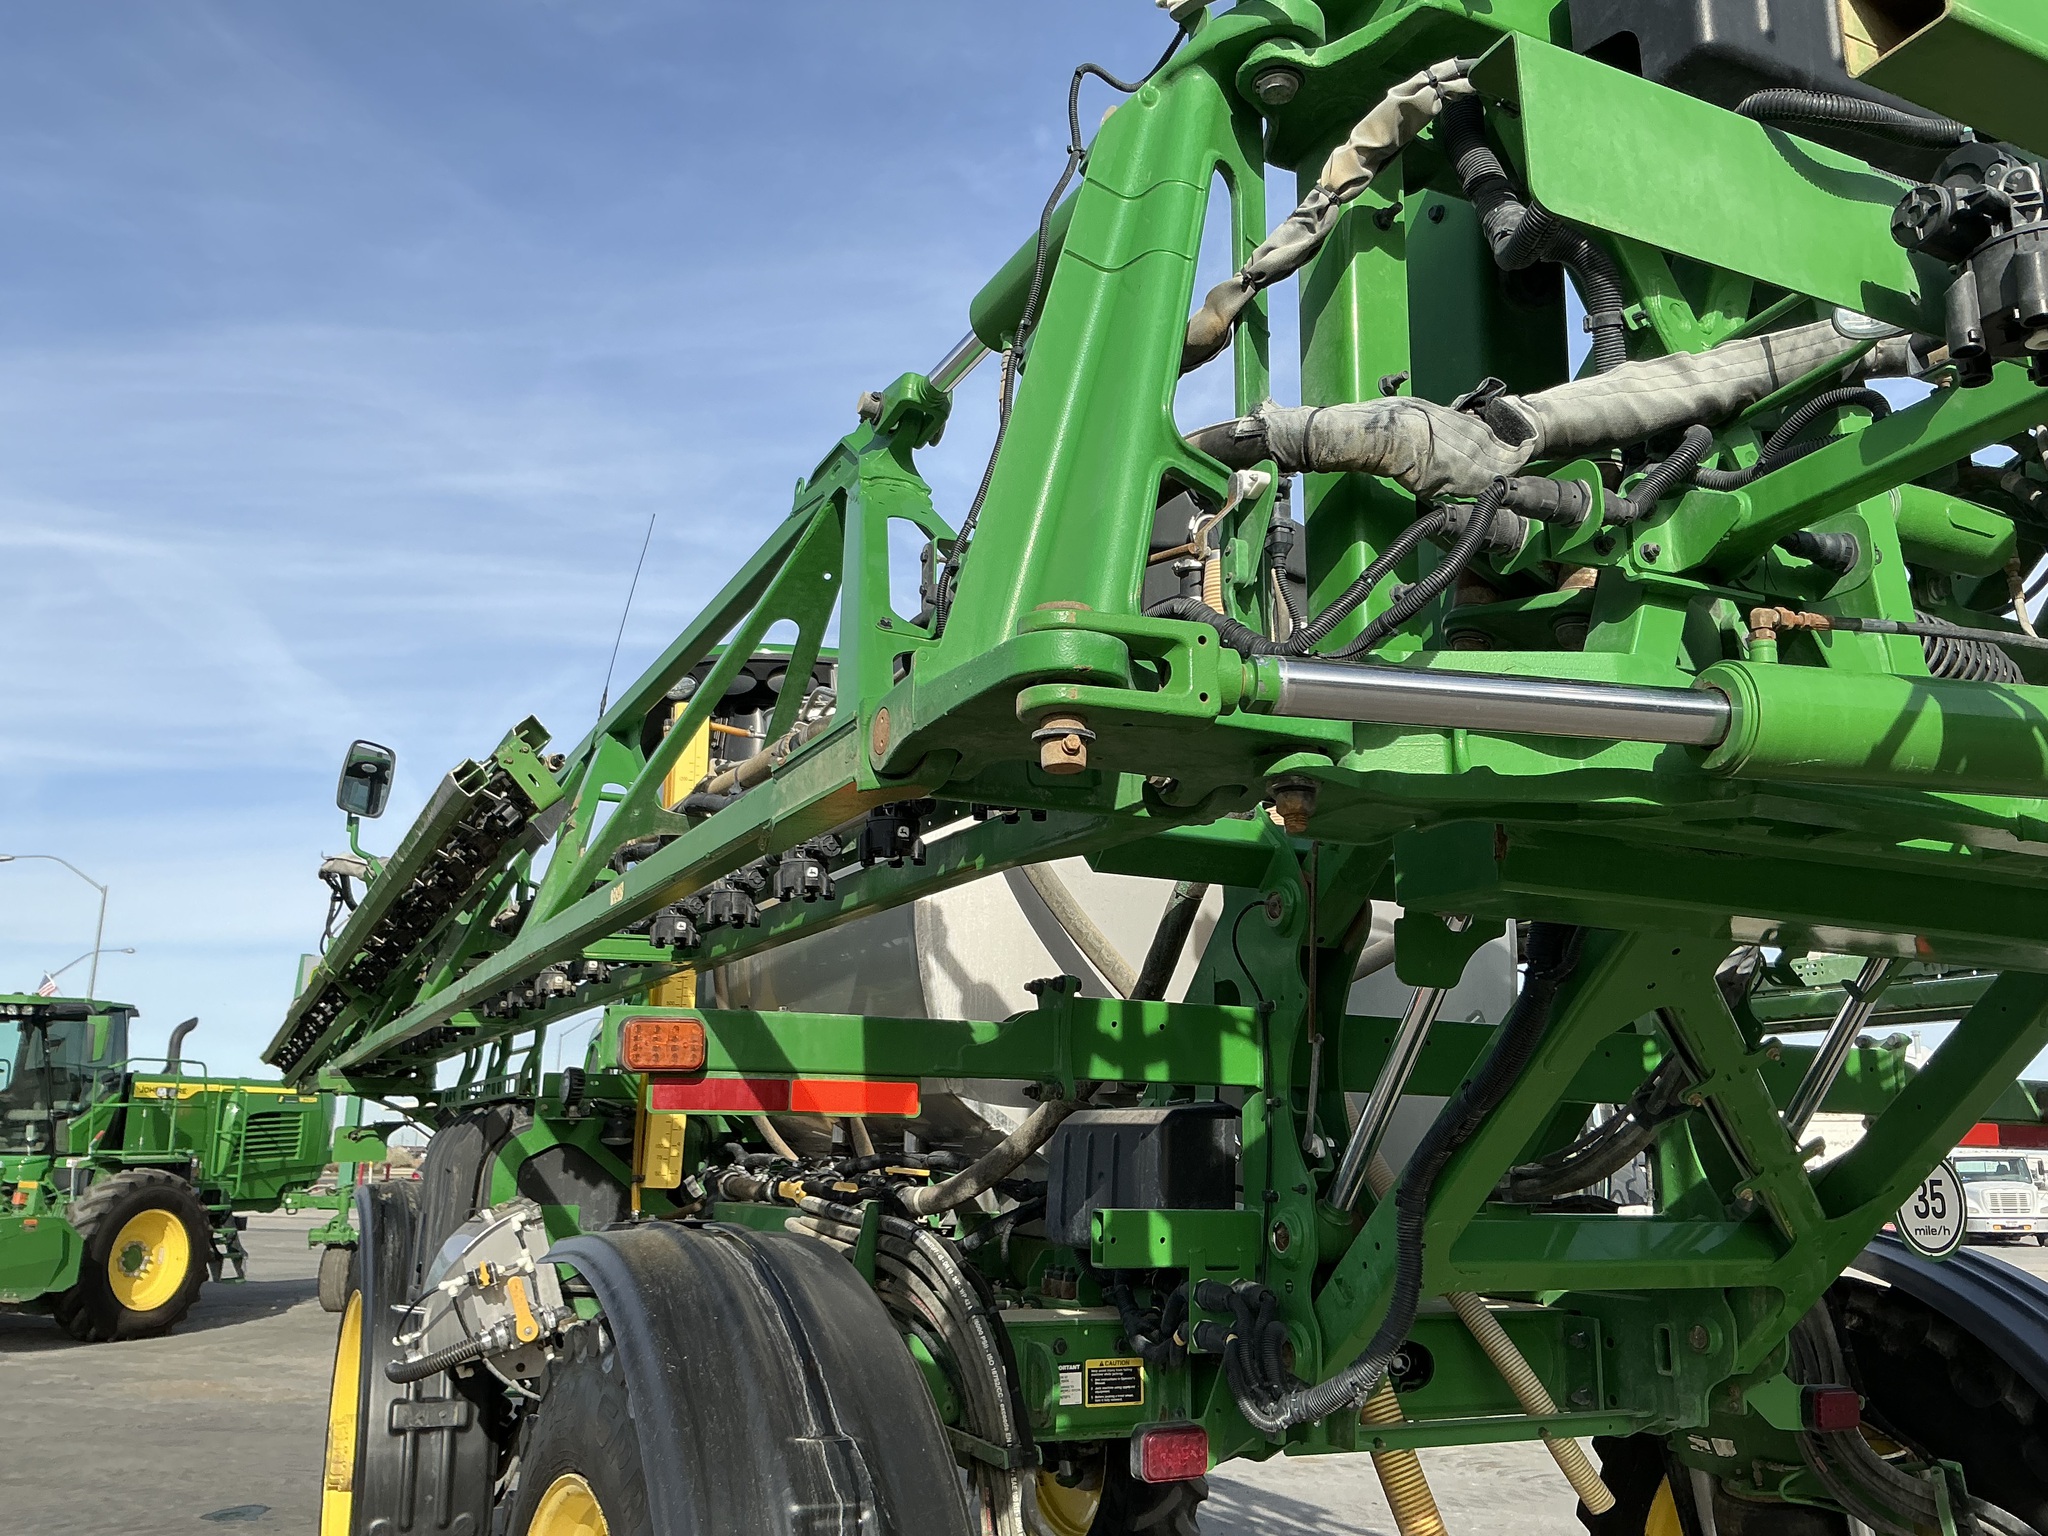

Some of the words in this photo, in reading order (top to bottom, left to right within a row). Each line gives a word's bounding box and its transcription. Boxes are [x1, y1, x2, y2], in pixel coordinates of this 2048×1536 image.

[1914, 1179, 1947, 1219] 35
[1914, 1225, 1951, 1236] mile/h
[986, 1353, 994, 1366] ISO
